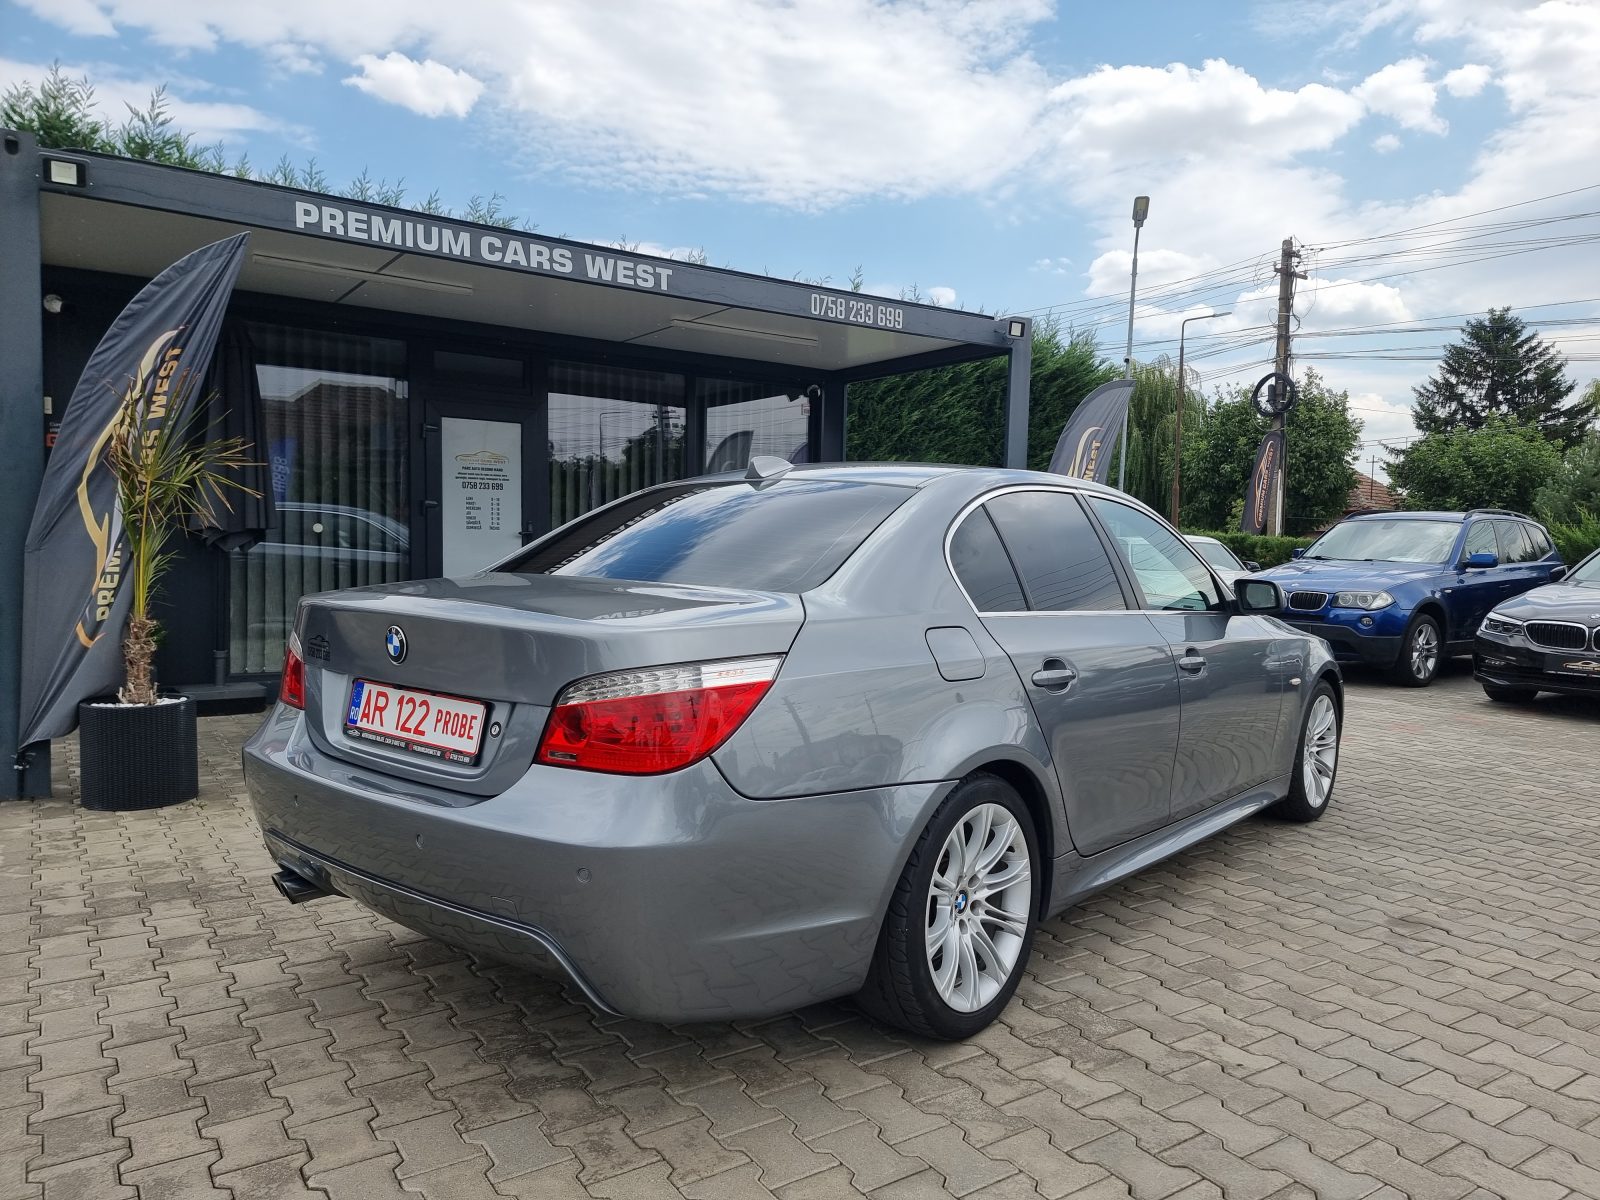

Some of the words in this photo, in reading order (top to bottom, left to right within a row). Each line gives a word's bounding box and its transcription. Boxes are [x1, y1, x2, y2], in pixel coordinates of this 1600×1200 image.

[295, 200, 471, 257] PREMIUM
[480, 236, 572, 274] CARS
[584, 254, 673, 291] WEST
[811, 293, 846, 319] 0758
[849, 300, 874, 324] 233
[877, 305, 903, 329] 699
[461, 481, 478, 490] 0758
[478, 482, 490, 490] 233
[491, 483, 504, 491] 699
[350, 706, 359, 721] RO
[360, 689, 390, 727] AR
[395, 694, 431, 737] 122
[433, 708, 478, 740] PROBE
